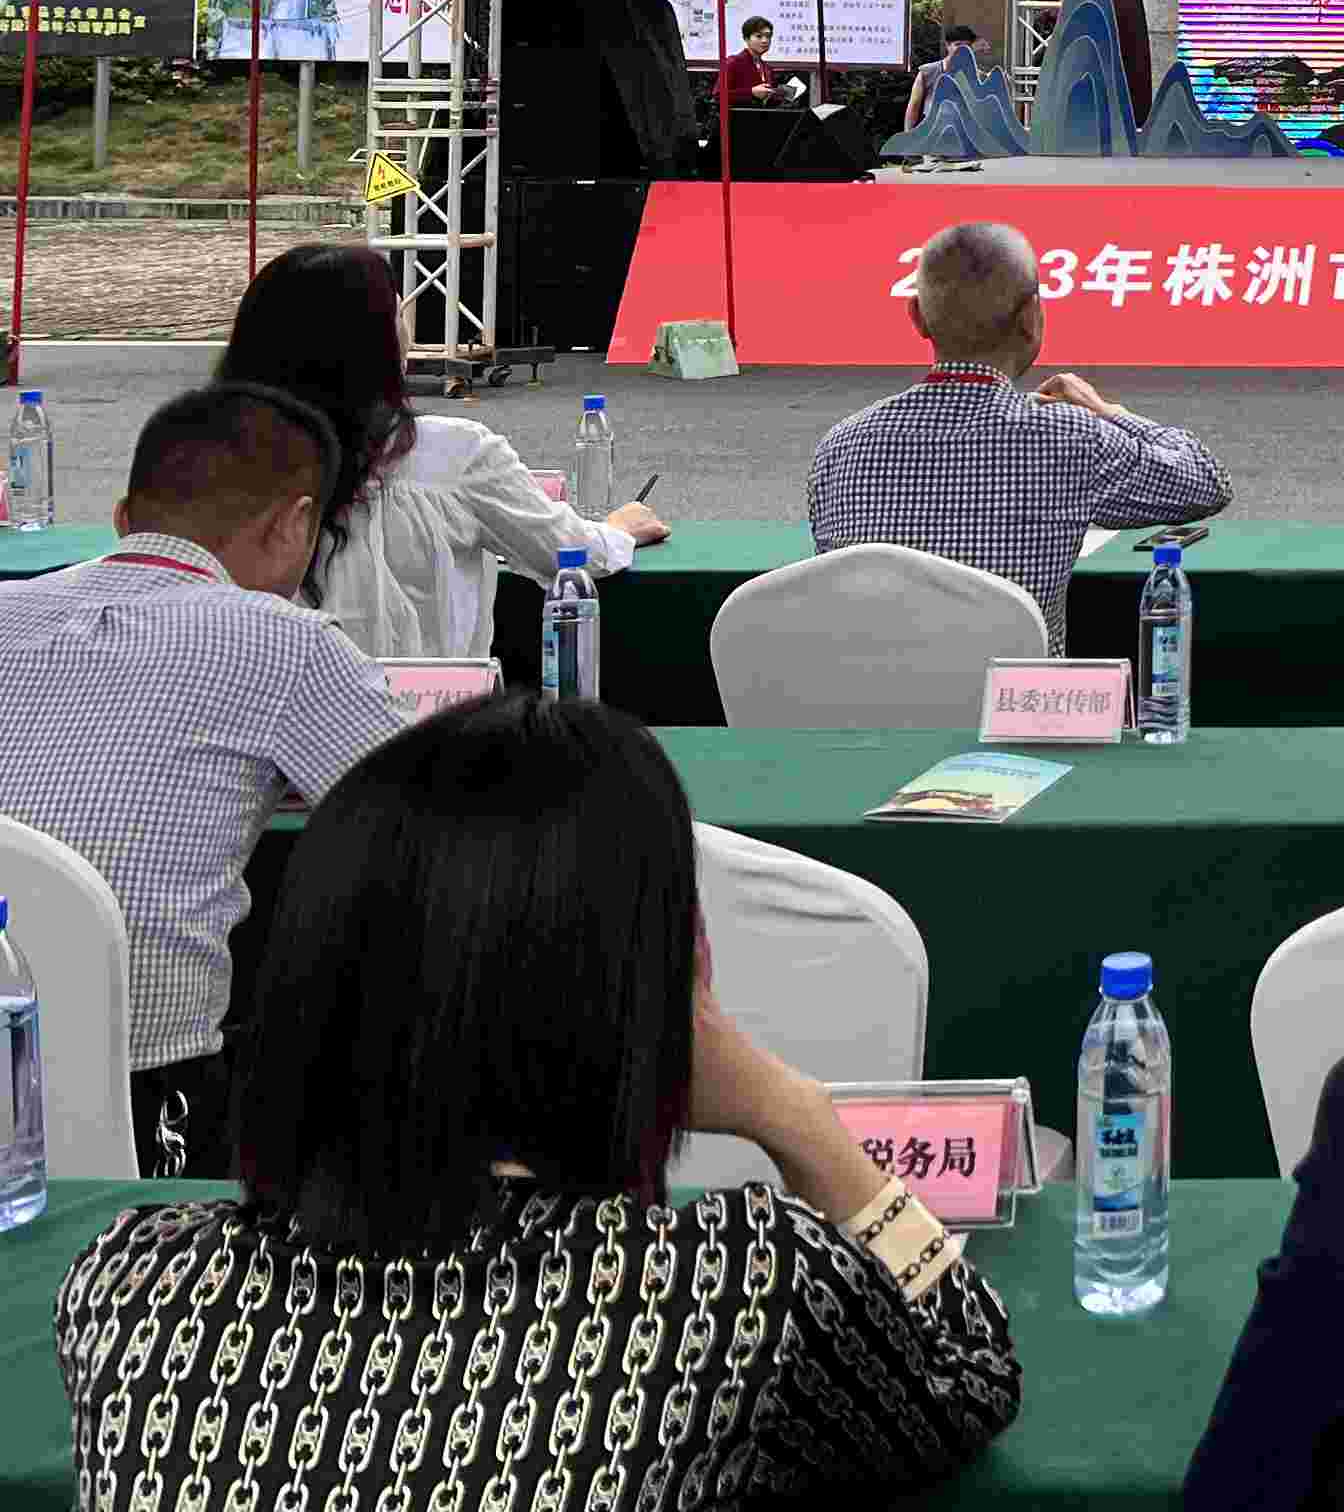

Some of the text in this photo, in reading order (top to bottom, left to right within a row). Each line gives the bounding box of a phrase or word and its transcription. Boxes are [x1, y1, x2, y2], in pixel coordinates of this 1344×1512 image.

[997, 687, 1112, 715] 县委宣传部
[862, 1136, 977, 1179] 税务局
